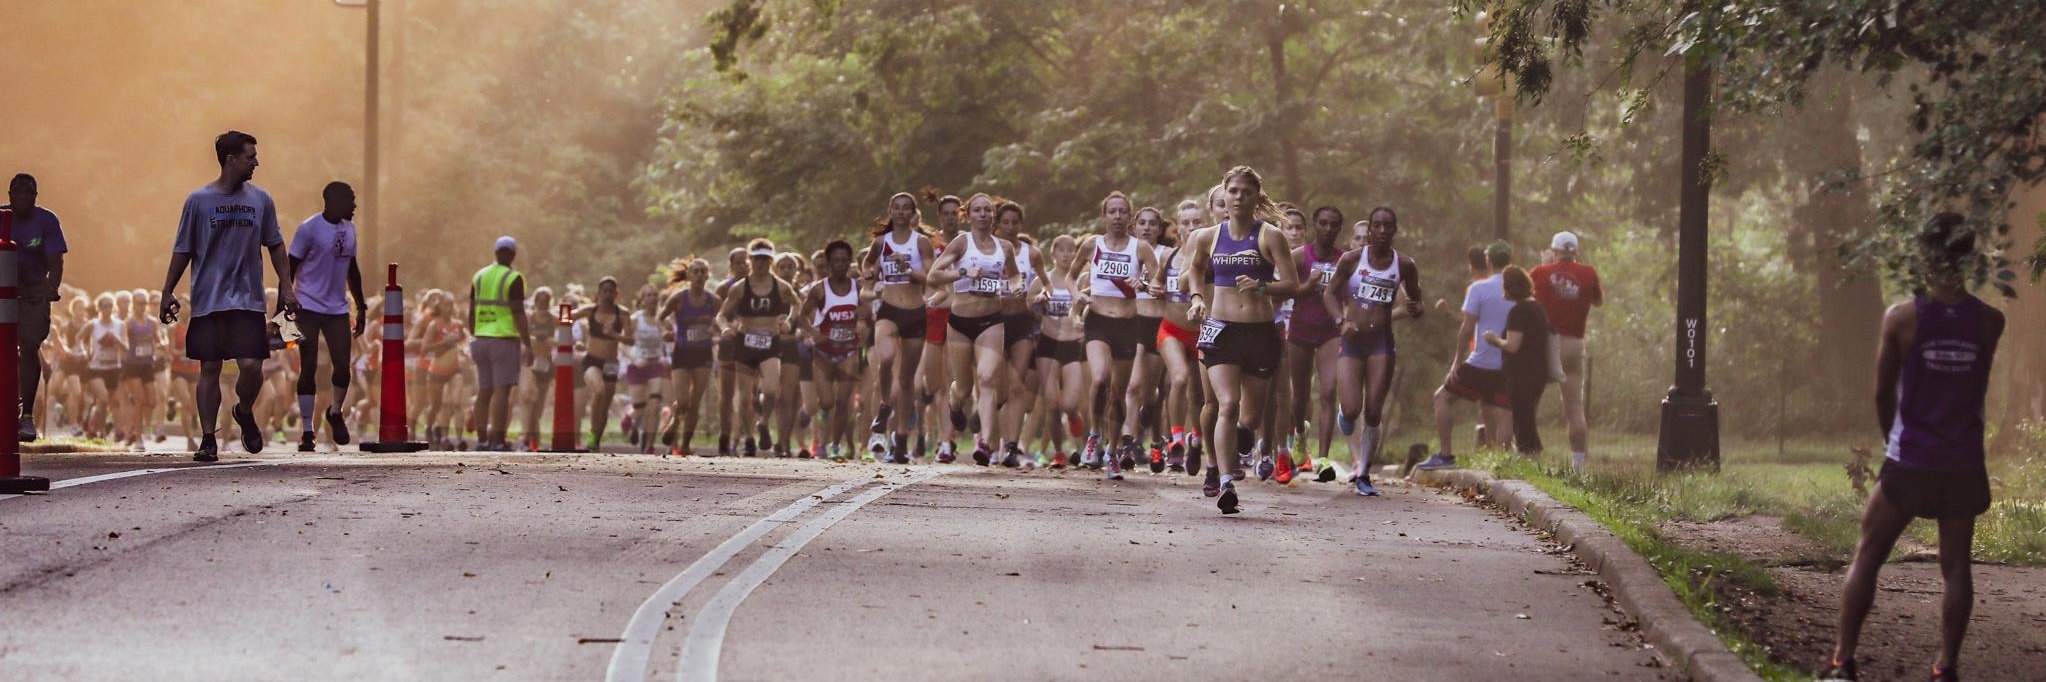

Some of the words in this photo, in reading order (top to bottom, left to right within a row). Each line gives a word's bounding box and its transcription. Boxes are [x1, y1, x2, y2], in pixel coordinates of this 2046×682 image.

[1213, 257, 1261, 265] WHIPPETS
[1104, 261, 1129, 275] 2909
[977, 279, 998, 291] 1597
[1371, 287, 1389, 301] 743
